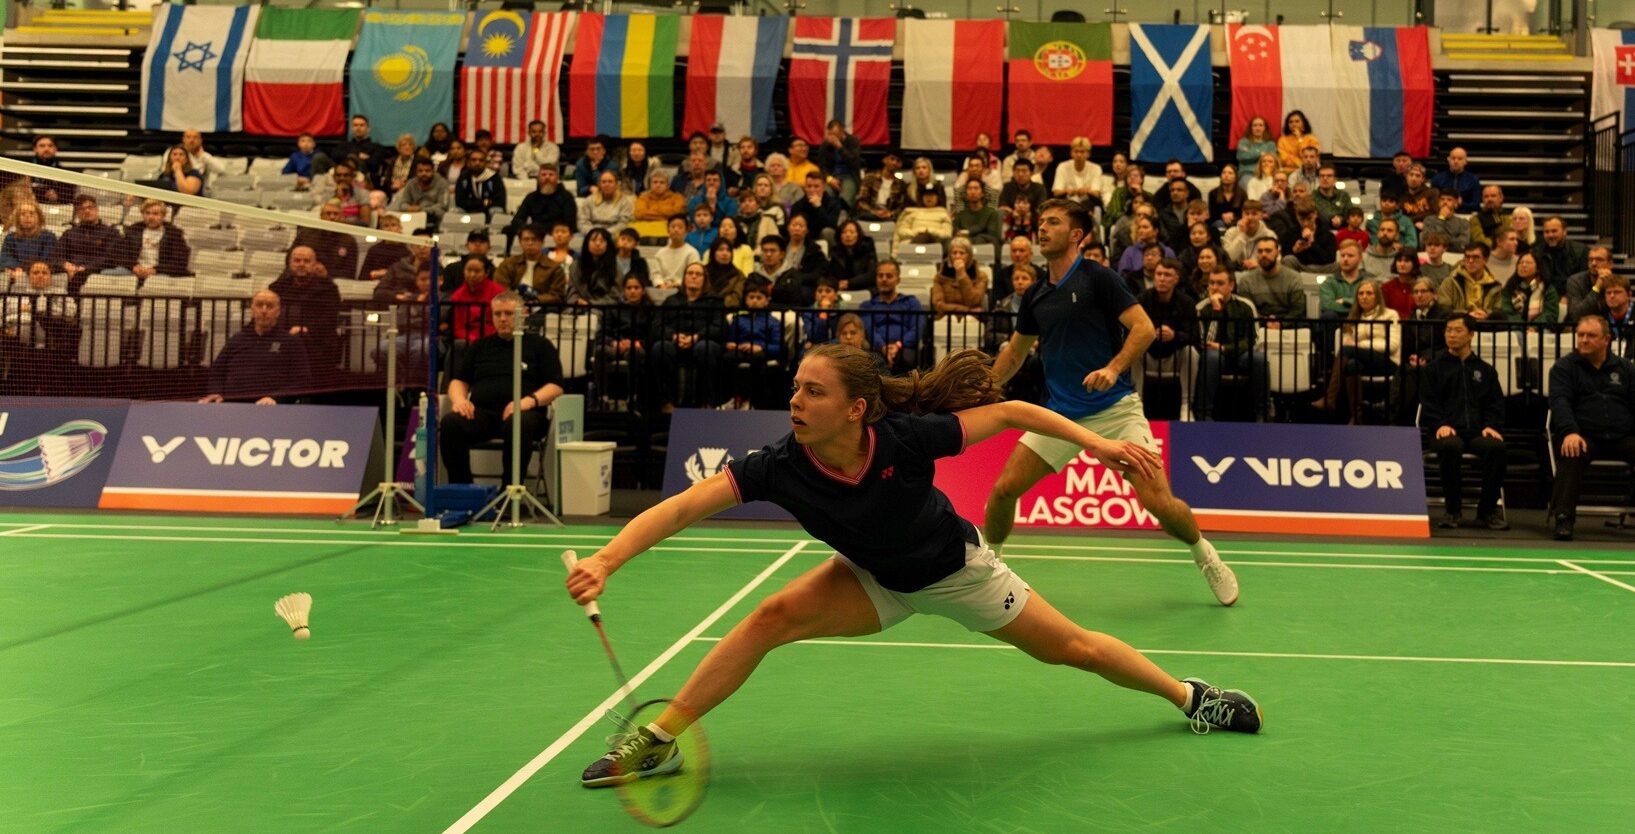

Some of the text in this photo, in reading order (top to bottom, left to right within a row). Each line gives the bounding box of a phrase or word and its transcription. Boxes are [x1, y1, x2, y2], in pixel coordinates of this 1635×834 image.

[193, 436, 350, 469] VICTOR
[1065, 466, 1138, 496] MA
[1243, 456, 1404, 490] VICTOR
[985, 496, 1161, 527] LASGOW
